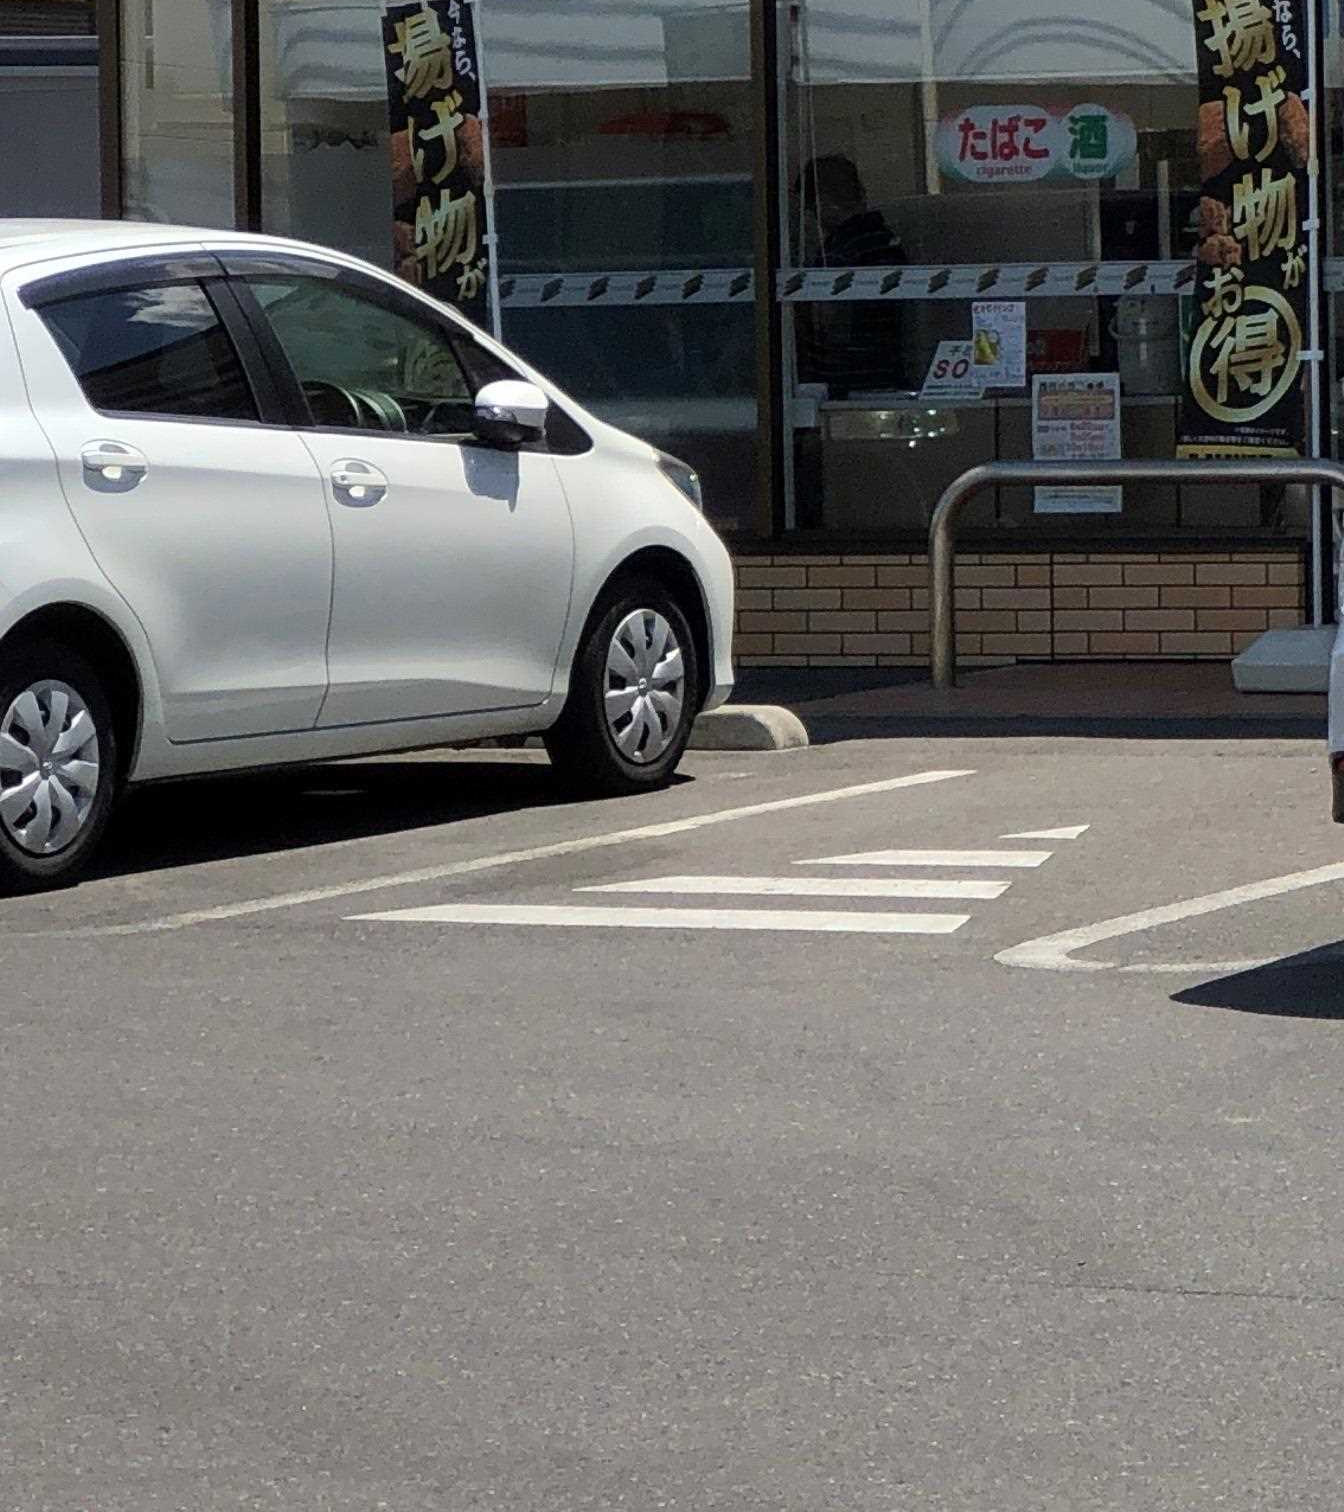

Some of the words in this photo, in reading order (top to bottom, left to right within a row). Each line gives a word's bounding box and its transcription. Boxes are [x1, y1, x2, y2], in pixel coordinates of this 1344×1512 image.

[958, 114, 1050, 162] たばこ
[1068, 115, 1108, 159] 酒
